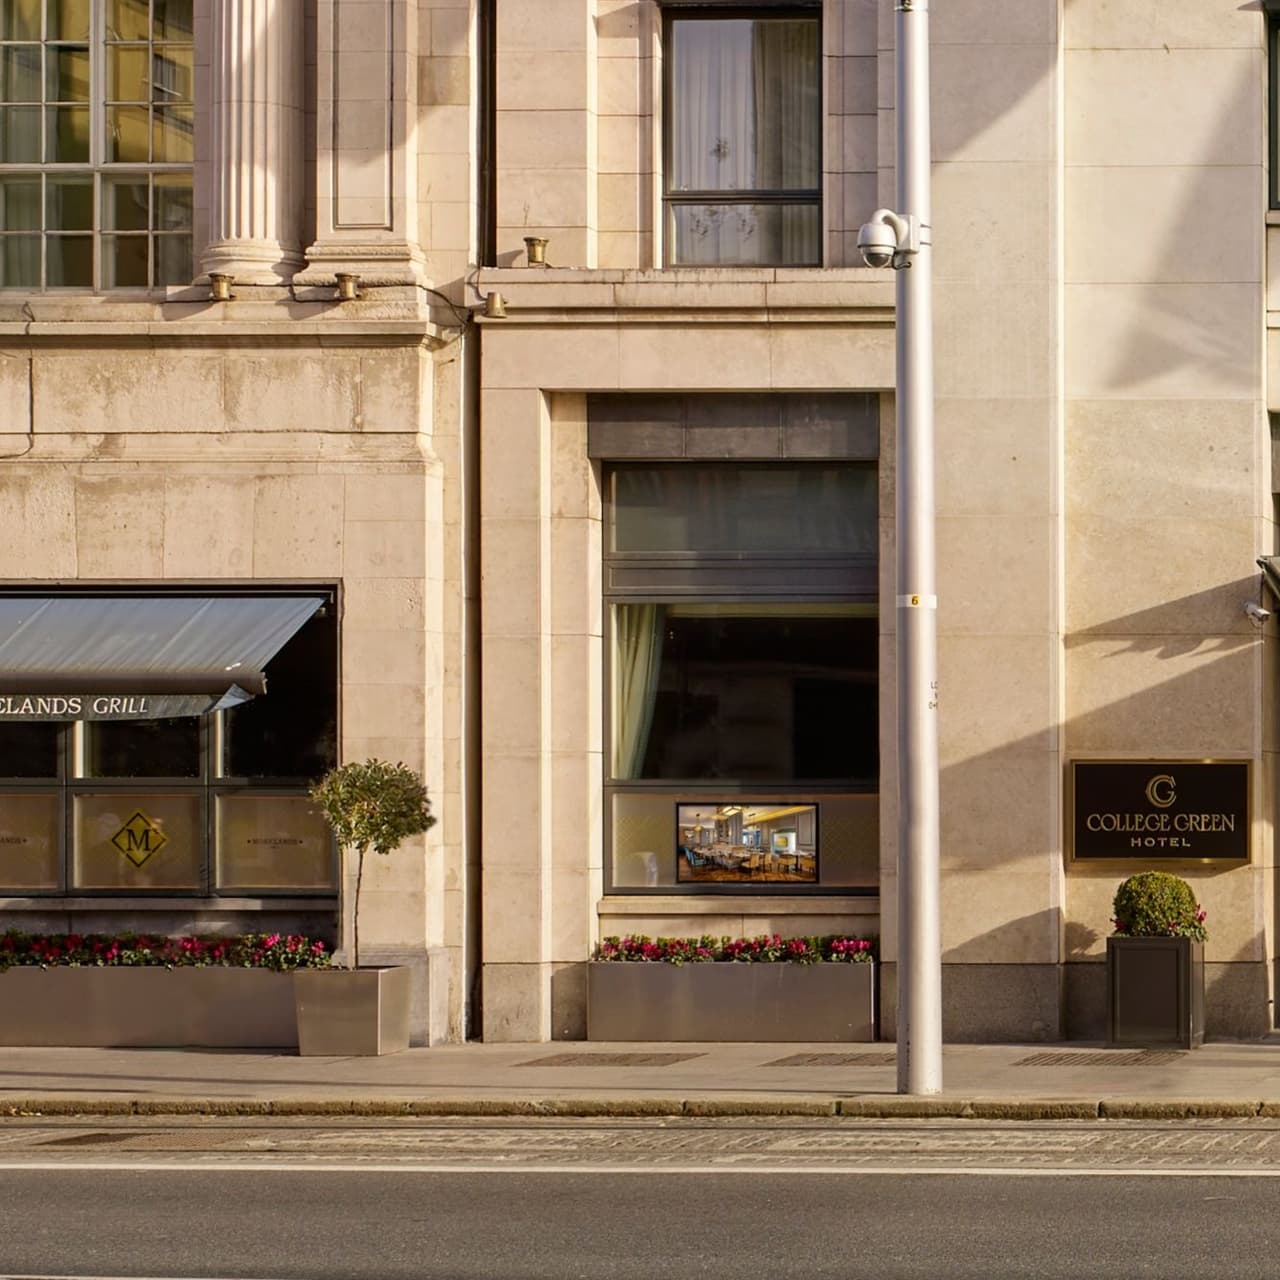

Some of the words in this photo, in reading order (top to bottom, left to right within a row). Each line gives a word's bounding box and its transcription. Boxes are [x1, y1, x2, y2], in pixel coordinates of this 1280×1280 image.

[911, 595, 919, 606] 6
[93, 697, 148, 714] GRILL
[1087, 813, 1170, 832] COLLEGE
[1174, 813, 1235, 832] GREEN
[126, 828, 151, 851] M
[1130, 837, 1191, 847] HOTEL
